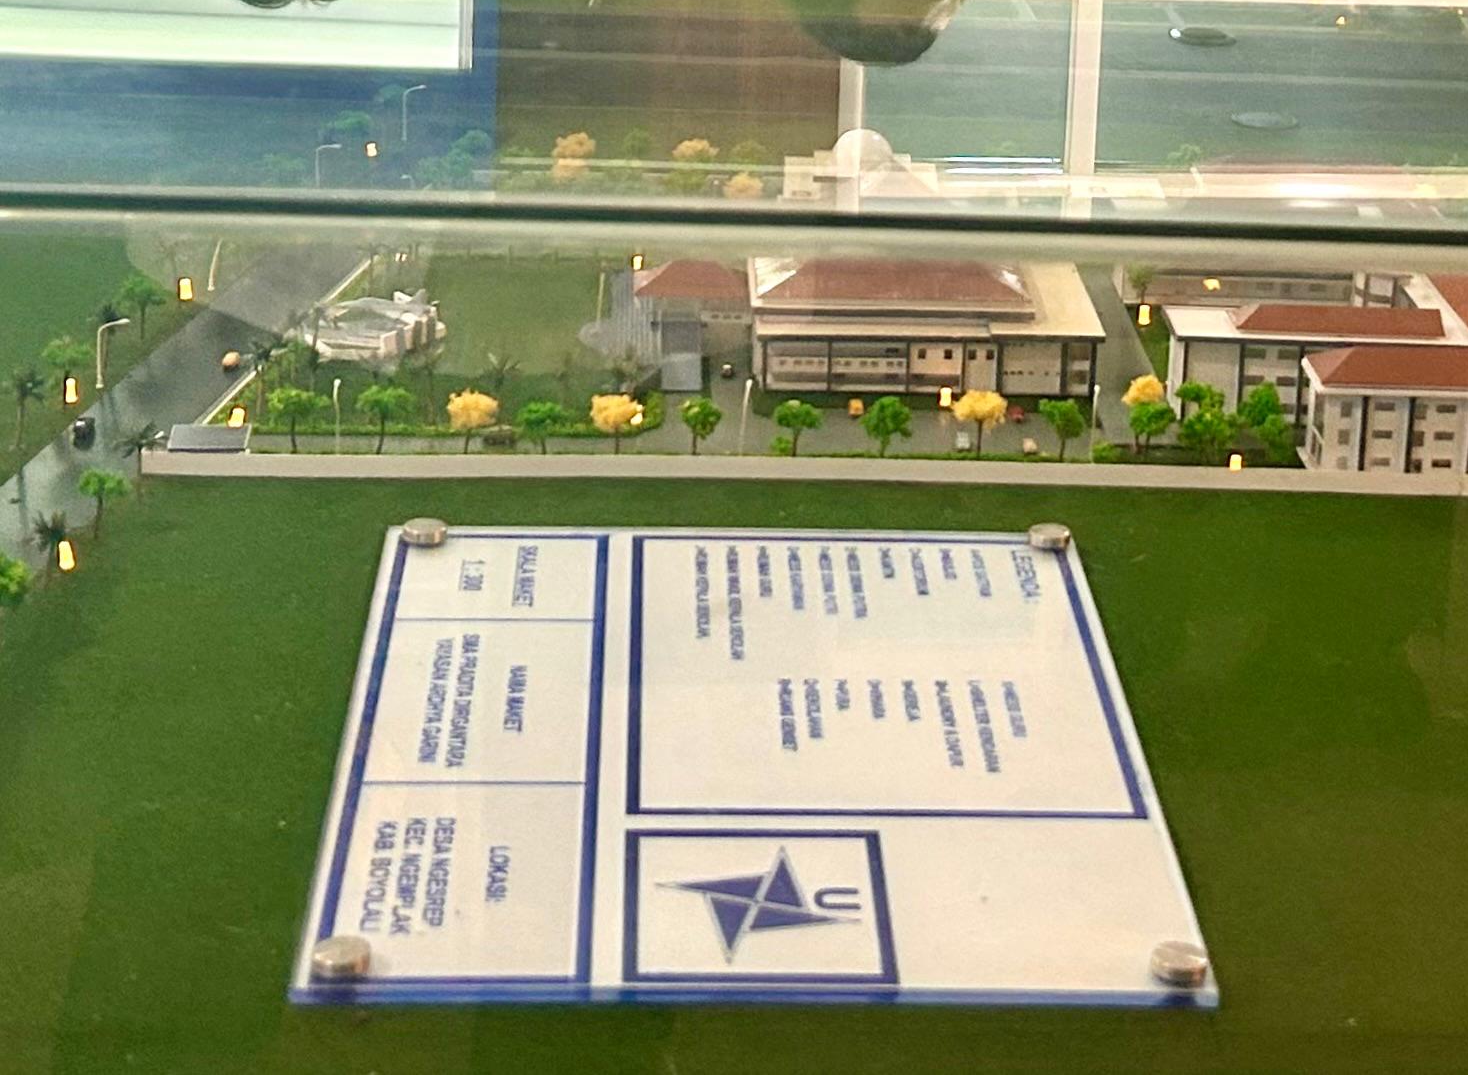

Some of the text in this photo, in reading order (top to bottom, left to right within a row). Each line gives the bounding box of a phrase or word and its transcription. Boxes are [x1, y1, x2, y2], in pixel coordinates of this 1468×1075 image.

[503, 696, 526, 731] MAKET
[360, 858, 392, 933] BOYOLALI
[391, 854, 421, 935] NGEMPLAK
[422, 817, 457, 927] DESA NGESREP
[815, 887, 862, 909] U
